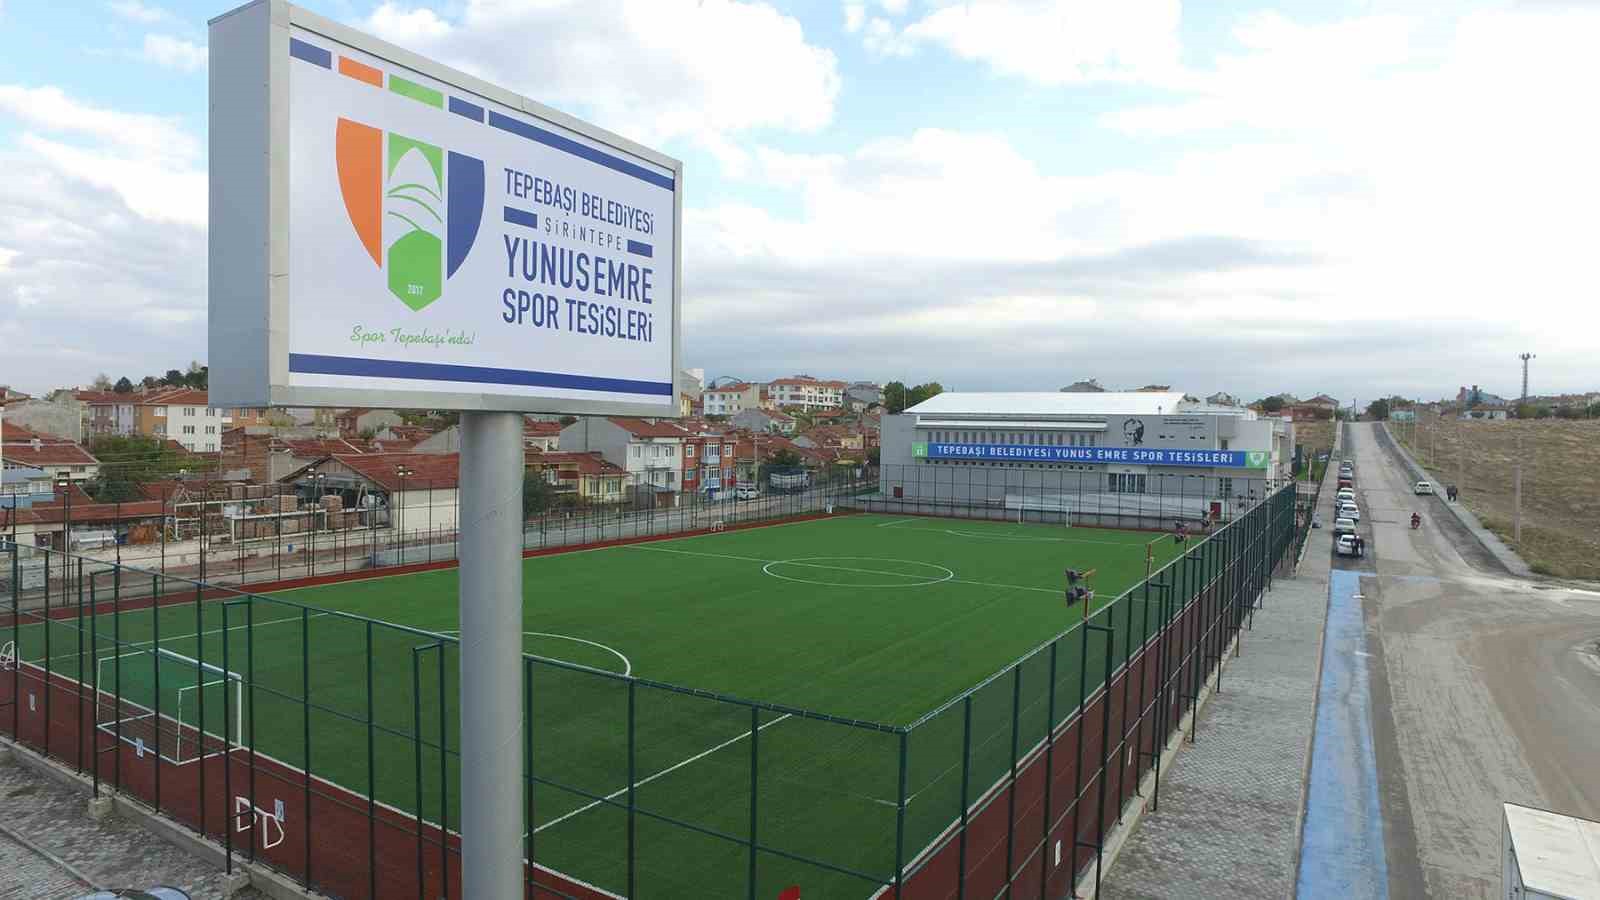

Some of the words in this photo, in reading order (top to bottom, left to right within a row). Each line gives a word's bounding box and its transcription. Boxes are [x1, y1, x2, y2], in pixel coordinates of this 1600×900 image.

[504, 168, 576, 216] TEPEBAŞI
[408, 283, 424, 296] 2017
[502, 288, 559, 330] SPOR
[350, 325, 386, 349] Spor
[937, 445, 986, 457] TEPEBAŞI
[1055, 449, 1092, 459] YUNUS
[1097, 450, 1128, 460] EMRE
[1134, 451, 1163, 461] SPOR
